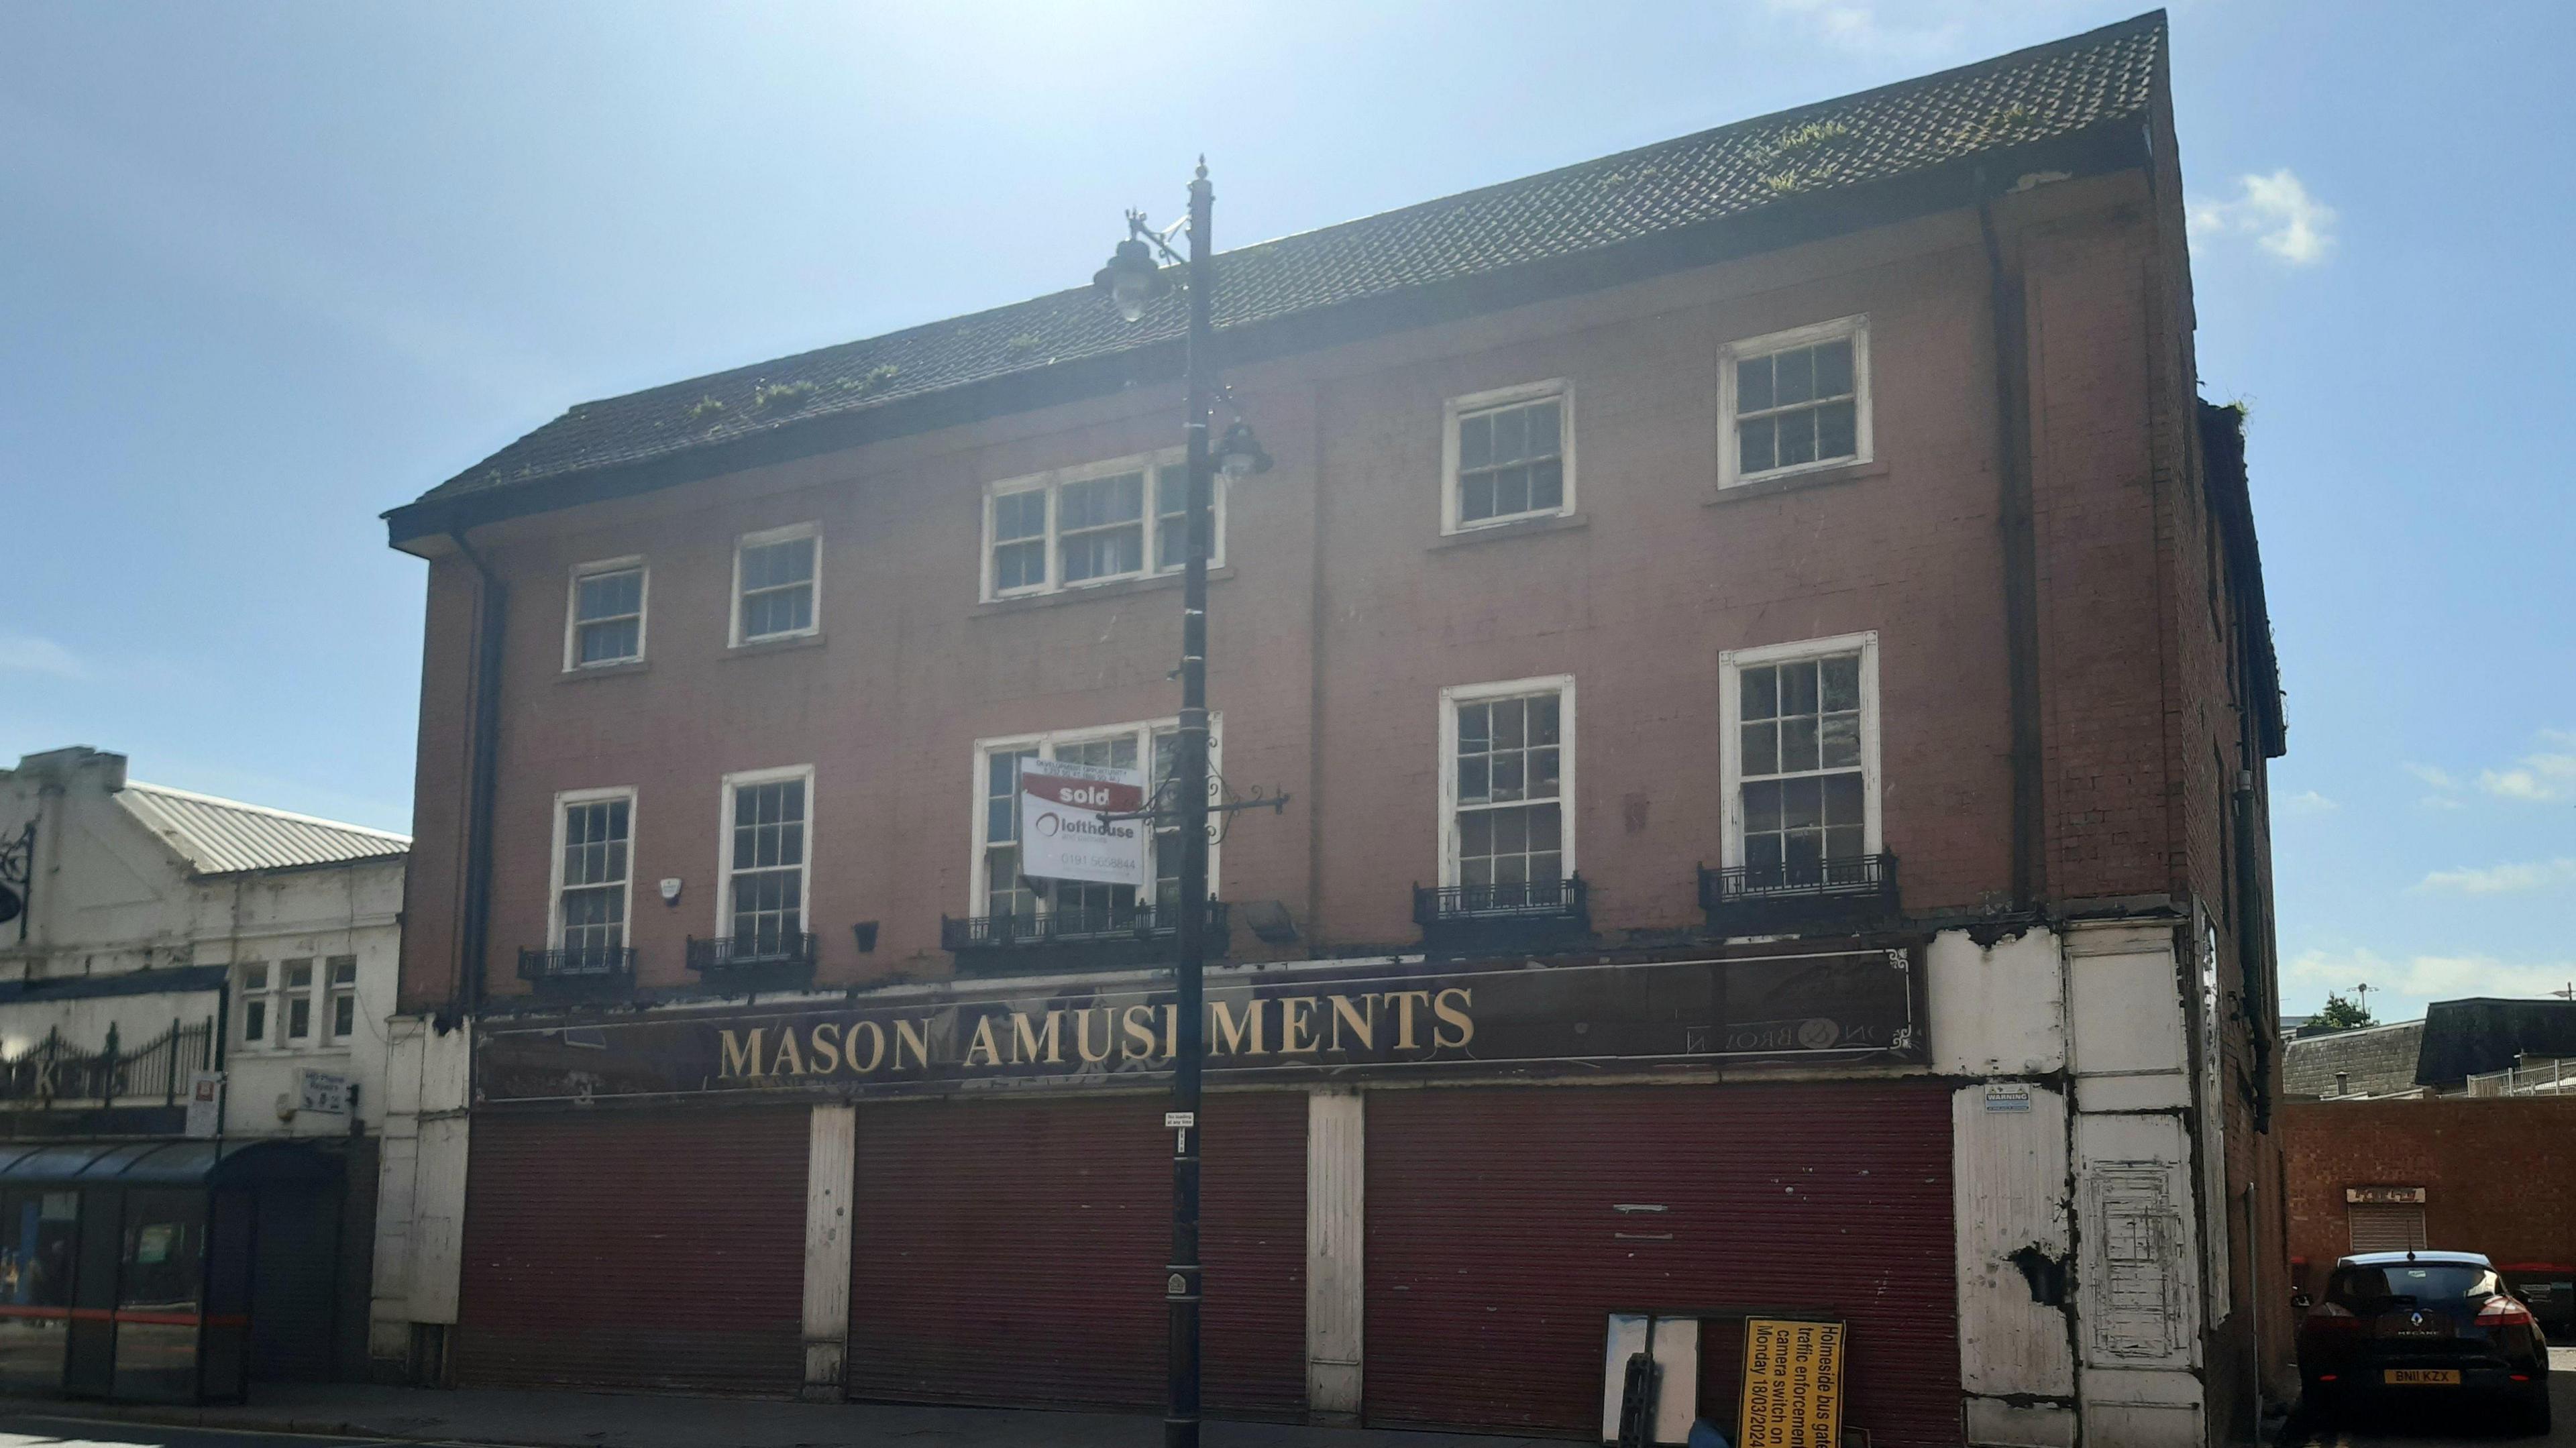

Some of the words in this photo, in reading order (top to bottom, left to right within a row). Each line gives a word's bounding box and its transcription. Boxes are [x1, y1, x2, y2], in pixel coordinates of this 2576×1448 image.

[1059, 786, 1110, 805] sold
[1061, 818, 1134, 838] lofthouse
[1061, 852, 1087, 865] 0191
[718, 1017, 934, 1079] MASON
[1750, 1325, 1773, 1375] Monday
[1774, 1329, 1789, 1376] camera
[1796, 1327, 1814, 1363] traffic
[1817, 1326, 1839, 1392] Holmeside
[2396, 1371, 2419, 1382] BN11
[2422, 1371, 2449, 1382] KZX
[1749, 1379, 1768, 1447] 18/03/2024
[1771, 1380, 1788, 1423] switch
[1816, 1395, 1835, 1420] bus
[1770, 1427, 1783, 1444] on
